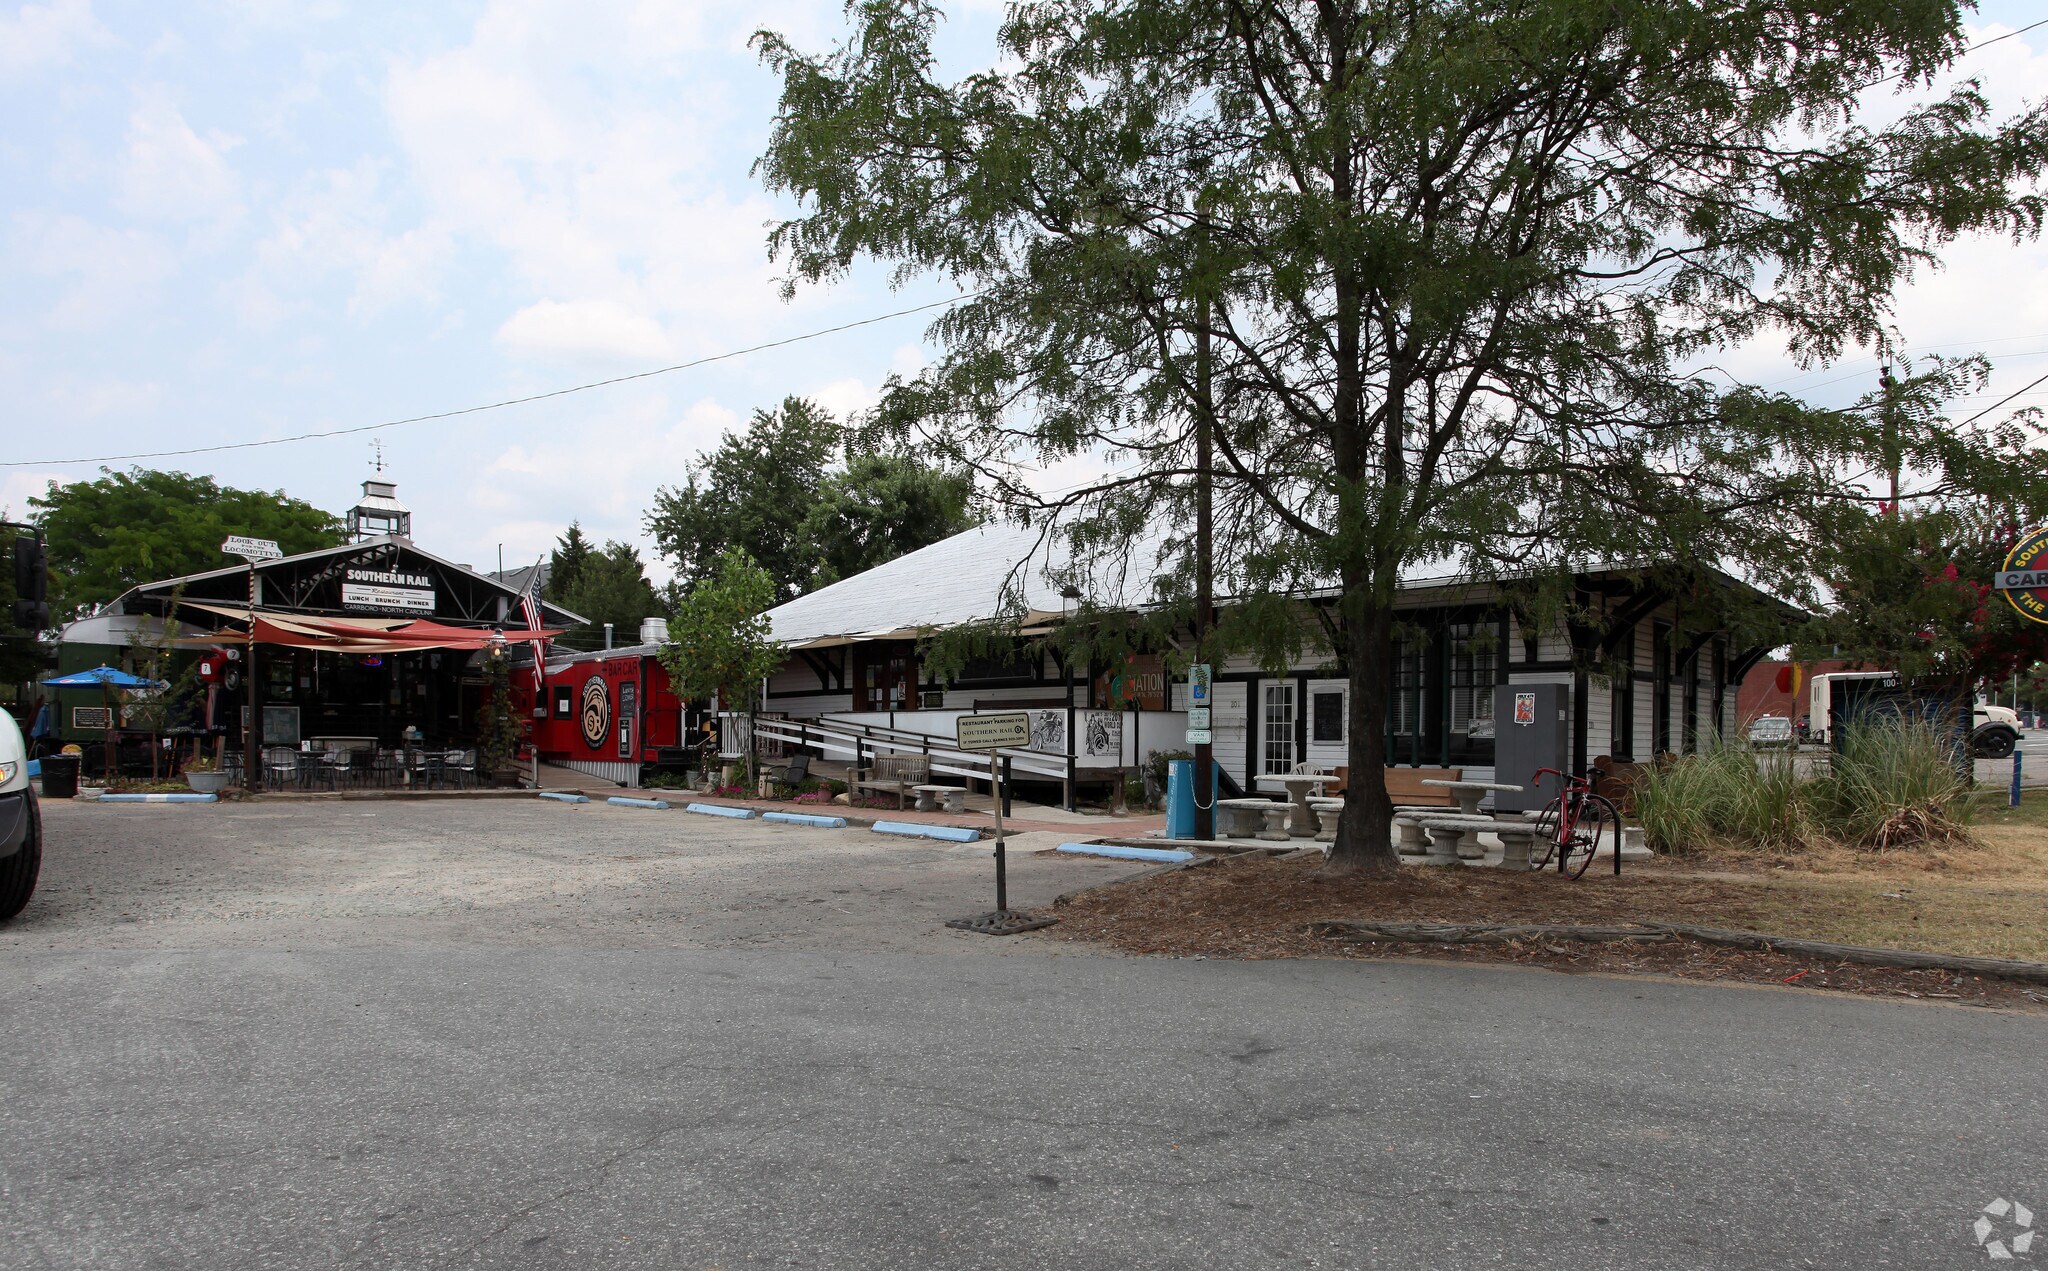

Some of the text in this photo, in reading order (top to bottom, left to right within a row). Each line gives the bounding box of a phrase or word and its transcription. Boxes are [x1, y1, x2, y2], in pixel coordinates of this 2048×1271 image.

[230, 536, 254, 545] LOOK
[224, 545, 281, 558] LOCOMOTIVE
[2014, 539, 2048, 567] SOUT
[347, 568, 432, 587] SOUTHERN RAIL
[371, 587, 405, 596] Restaurant
[375, 597, 401, 605] BRUNCH
[2019, 592, 2046, 613] THE
[344, 604, 433, 616] CARRBORO NORTH CAROLINA
[608, 660, 638, 676] BAR CAR
[962, 728, 998, 736] SOUTHERN
